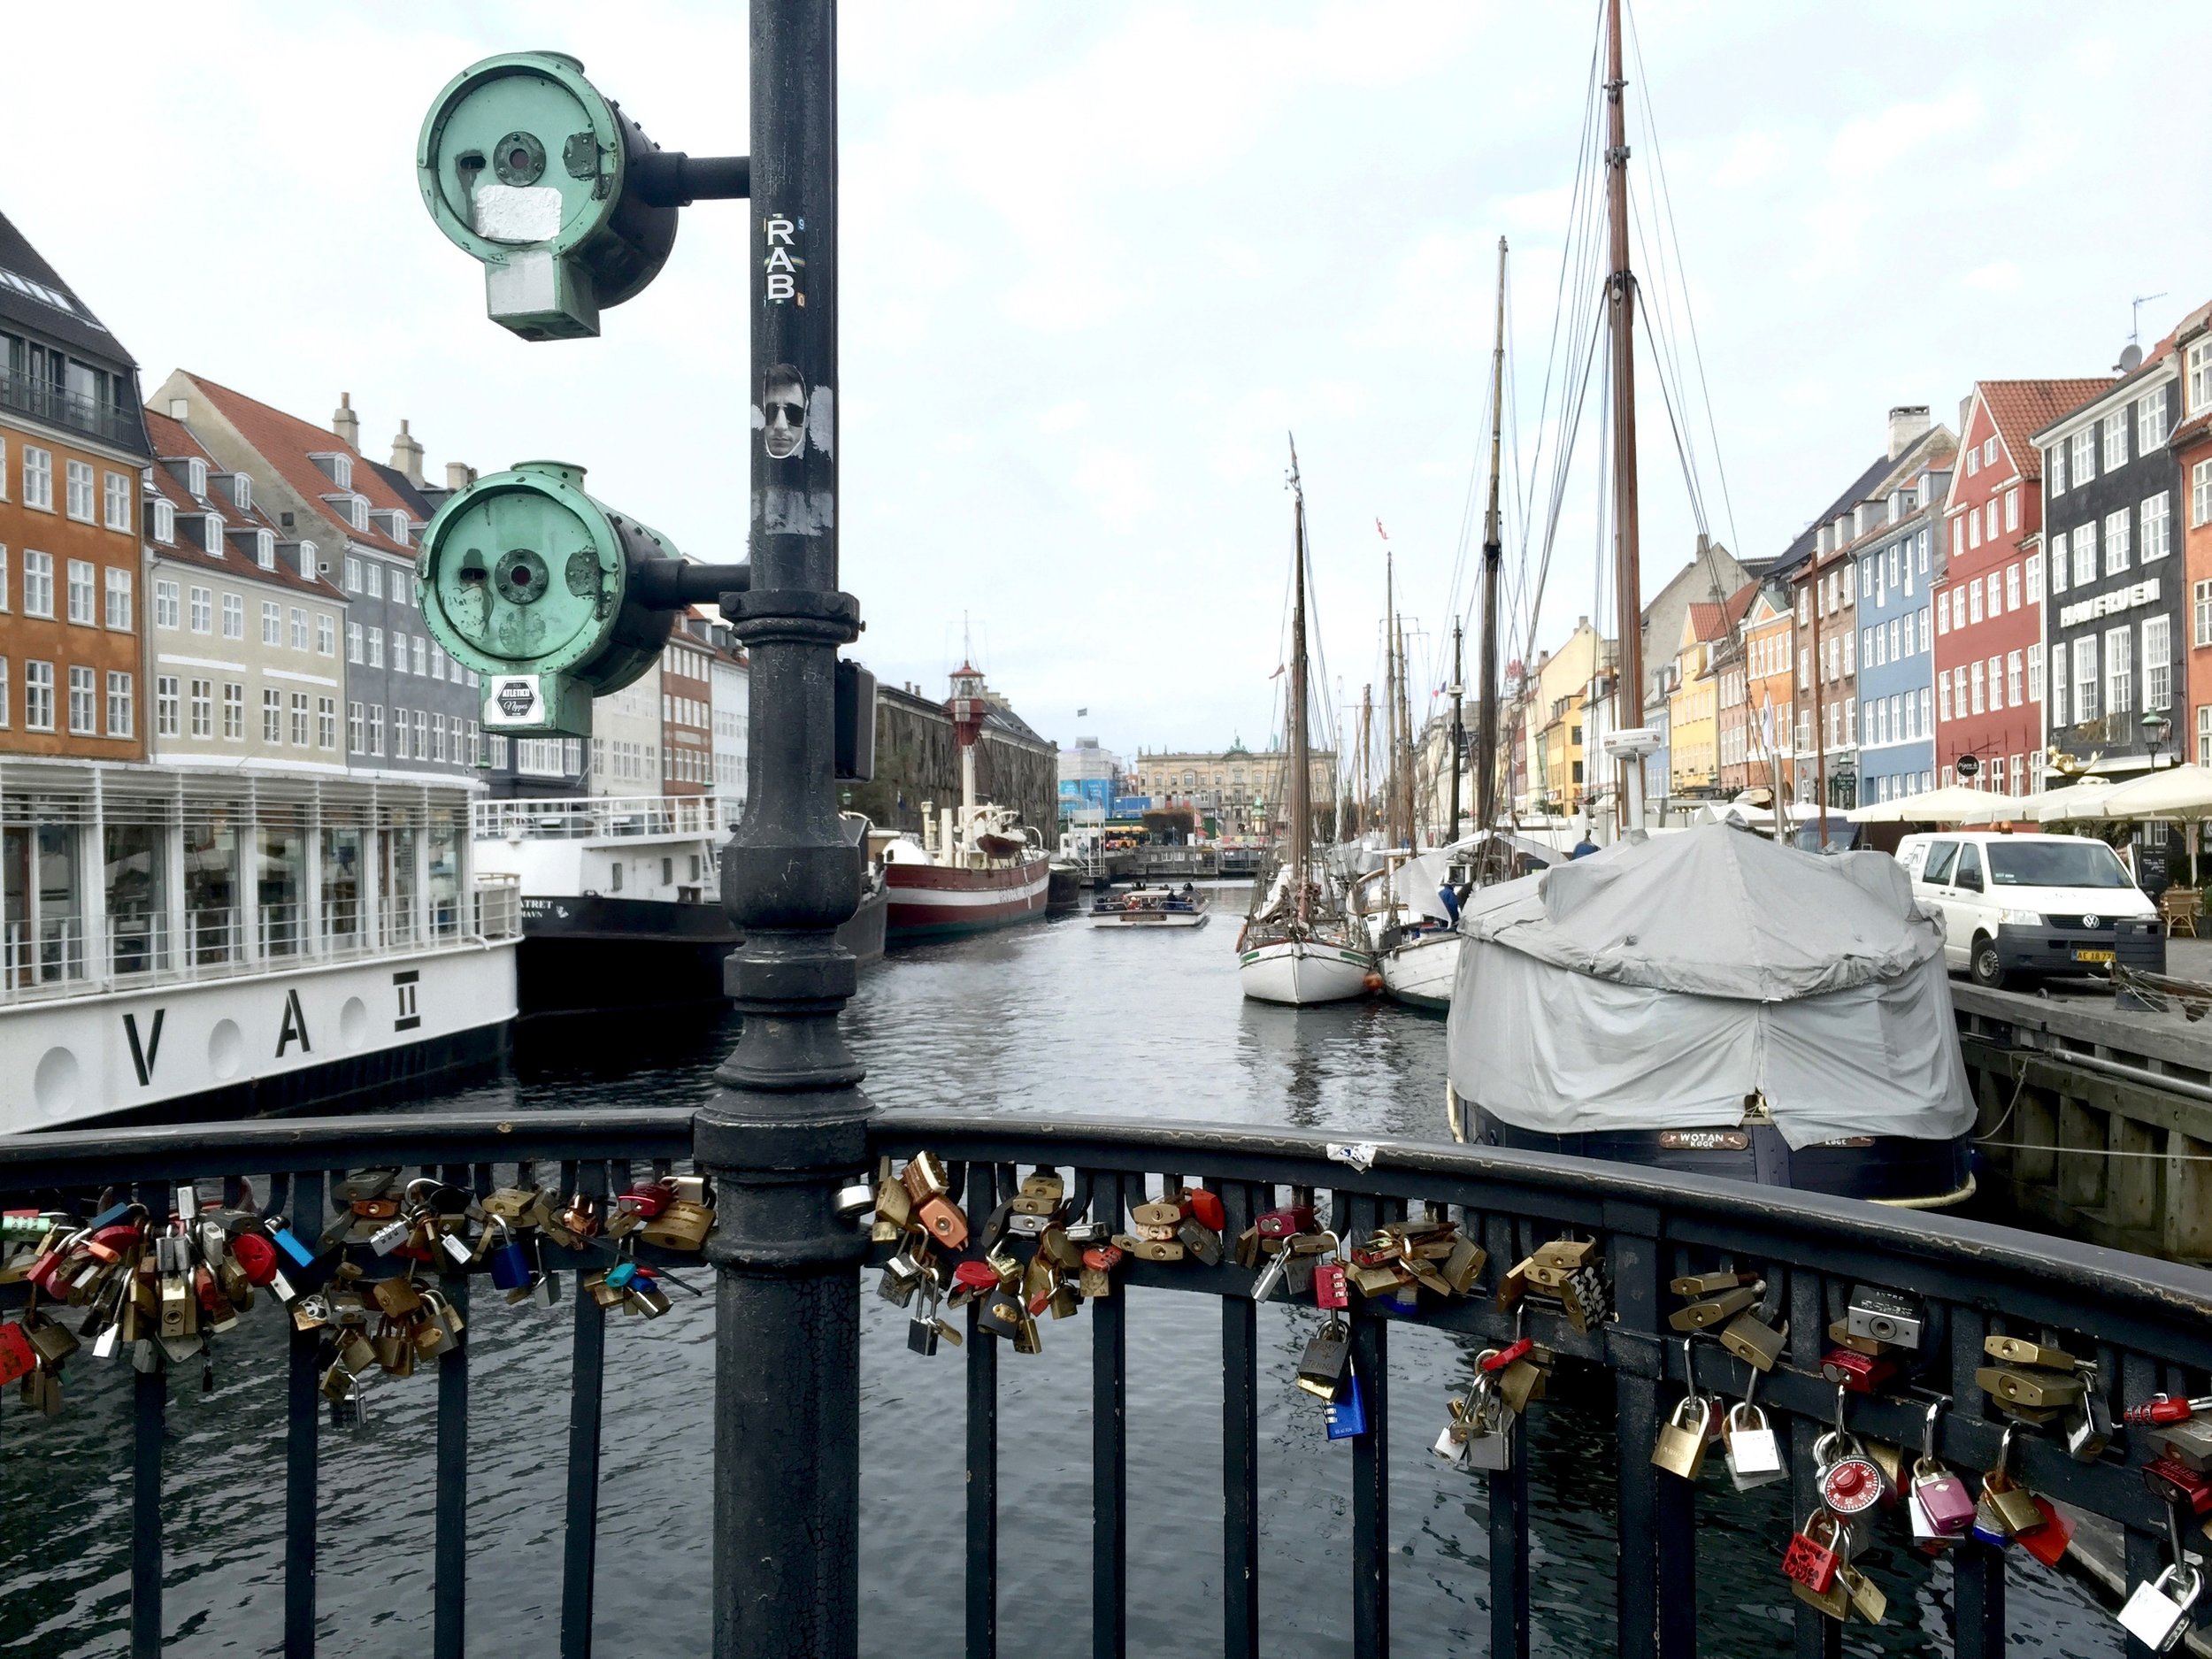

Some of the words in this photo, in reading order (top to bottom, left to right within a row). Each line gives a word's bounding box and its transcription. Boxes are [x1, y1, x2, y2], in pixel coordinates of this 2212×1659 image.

[766, 219, 797, 300] RAB
[2060, 578, 2161, 628] HAVFRUEN
[502, 688, 531, 698] ATLETICO
[1680, 1133, 1724, 1142] WOTAN
[2162, 1461, 2200, 1479] ABUS
[1858, 1492, 1867, 1501] 20
